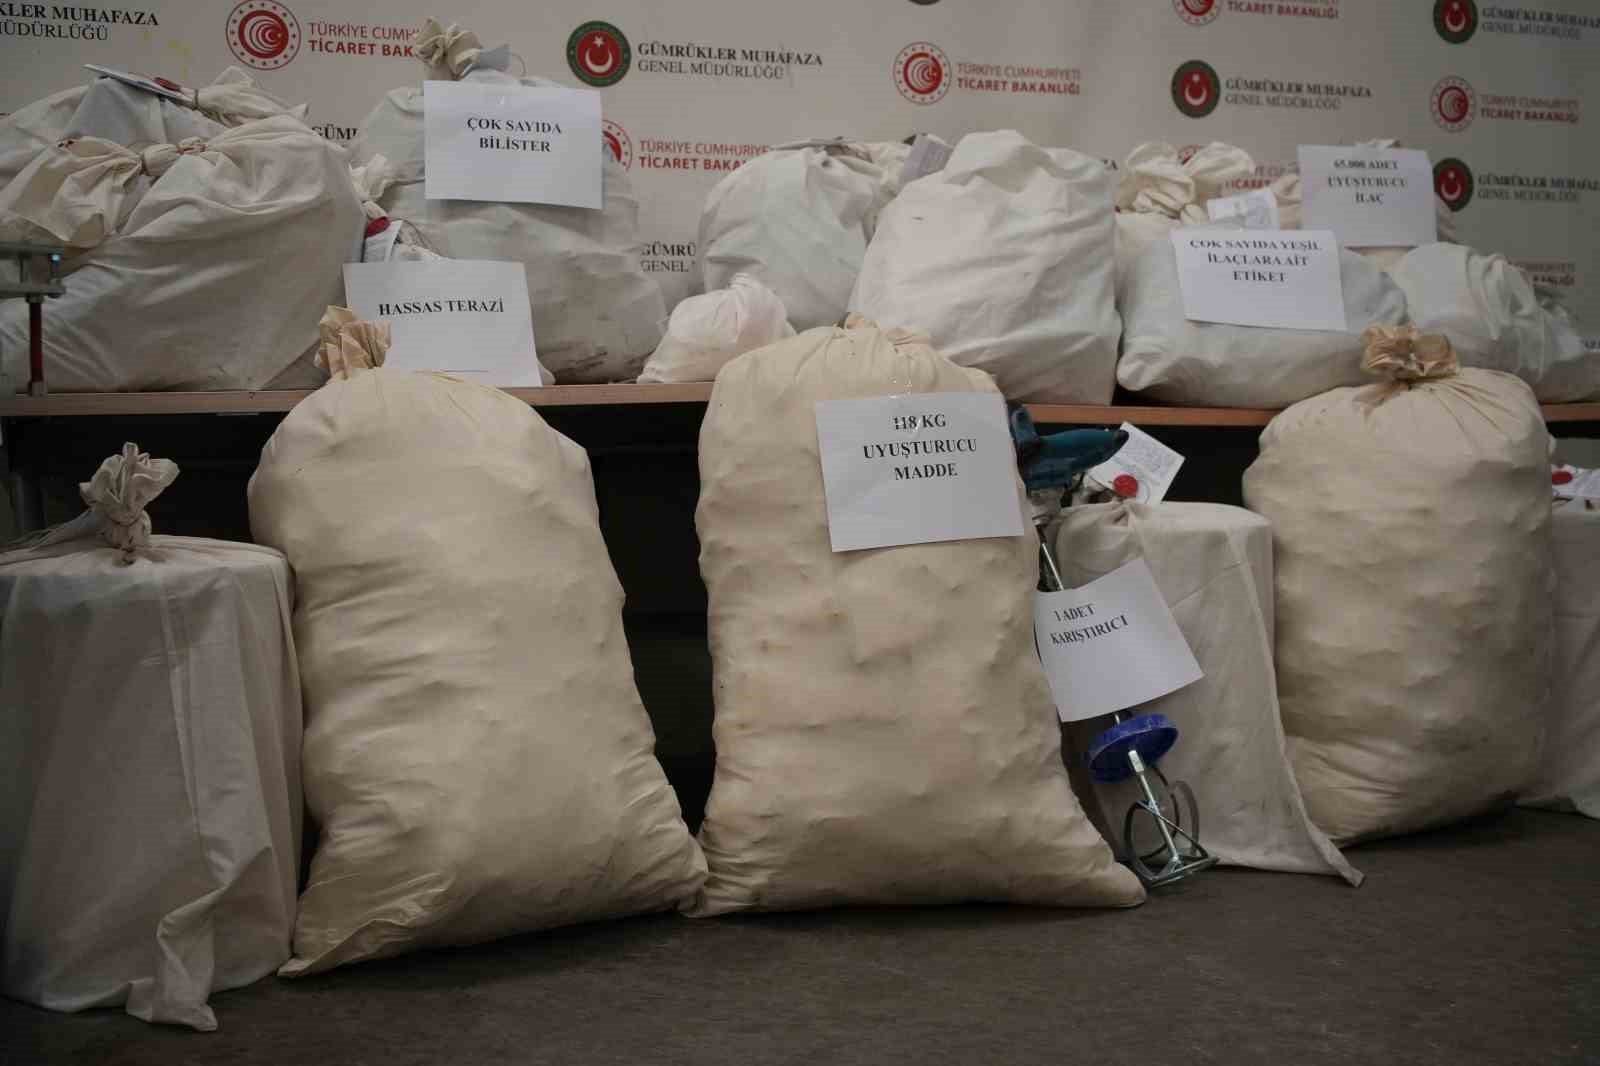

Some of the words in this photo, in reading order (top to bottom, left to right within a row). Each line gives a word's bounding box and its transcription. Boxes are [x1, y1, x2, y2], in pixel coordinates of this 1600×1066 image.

[51, 6, 159, 26] MUHAFAZA
[308, 20, 368, 38] TÜRKİYE
[308, 38, 376, 55] TİCARET
[382, 44, 414, 57] BAK
[638, 41, 737, 61] GÜMRÜKLER
[741, 48, 823, 66] MUHAFAZA
[638, 60, 687, 74] GENEL
[690, 61, 785, 80] MÜDÜRLÜĞÜ
[958, 78, 1008, 92] TİCARET
[1012, 81, 1080, 96] BAKANLIĞI
[1225, 77, 1303, 93] GÜMRÜKLER
[1306, 83, 1372, 97] MUHAFAZA
[467, 117, 501, 132] ÇOK
[505, 119, 562, 134] SAYIDA
[480, 135, 551, 152] BİLİSTER
[640, 138, 692, 153] TÜRKİYE
[640, 154, 699, 170] TİCARET
[1368, 159, 1399, 170] ADET
[1356, 191, 1385, 206] İLAÇ
[640, 260, 688, 273] GENEL
[1233, 270, 1286, 282] ETİKET
[379, 301, 443, 316] HASSAS
[448, 298, 504, 313] TERAZİ
[894, 415, 917, 430] 118
[922, 413, 946, 429] KG
[863, 439, 977, 459] UYUŞTURUCU
[894, 463, 959, 480] MADDE
[1050, 614, 1128, 645] KARIŞTIRICI
